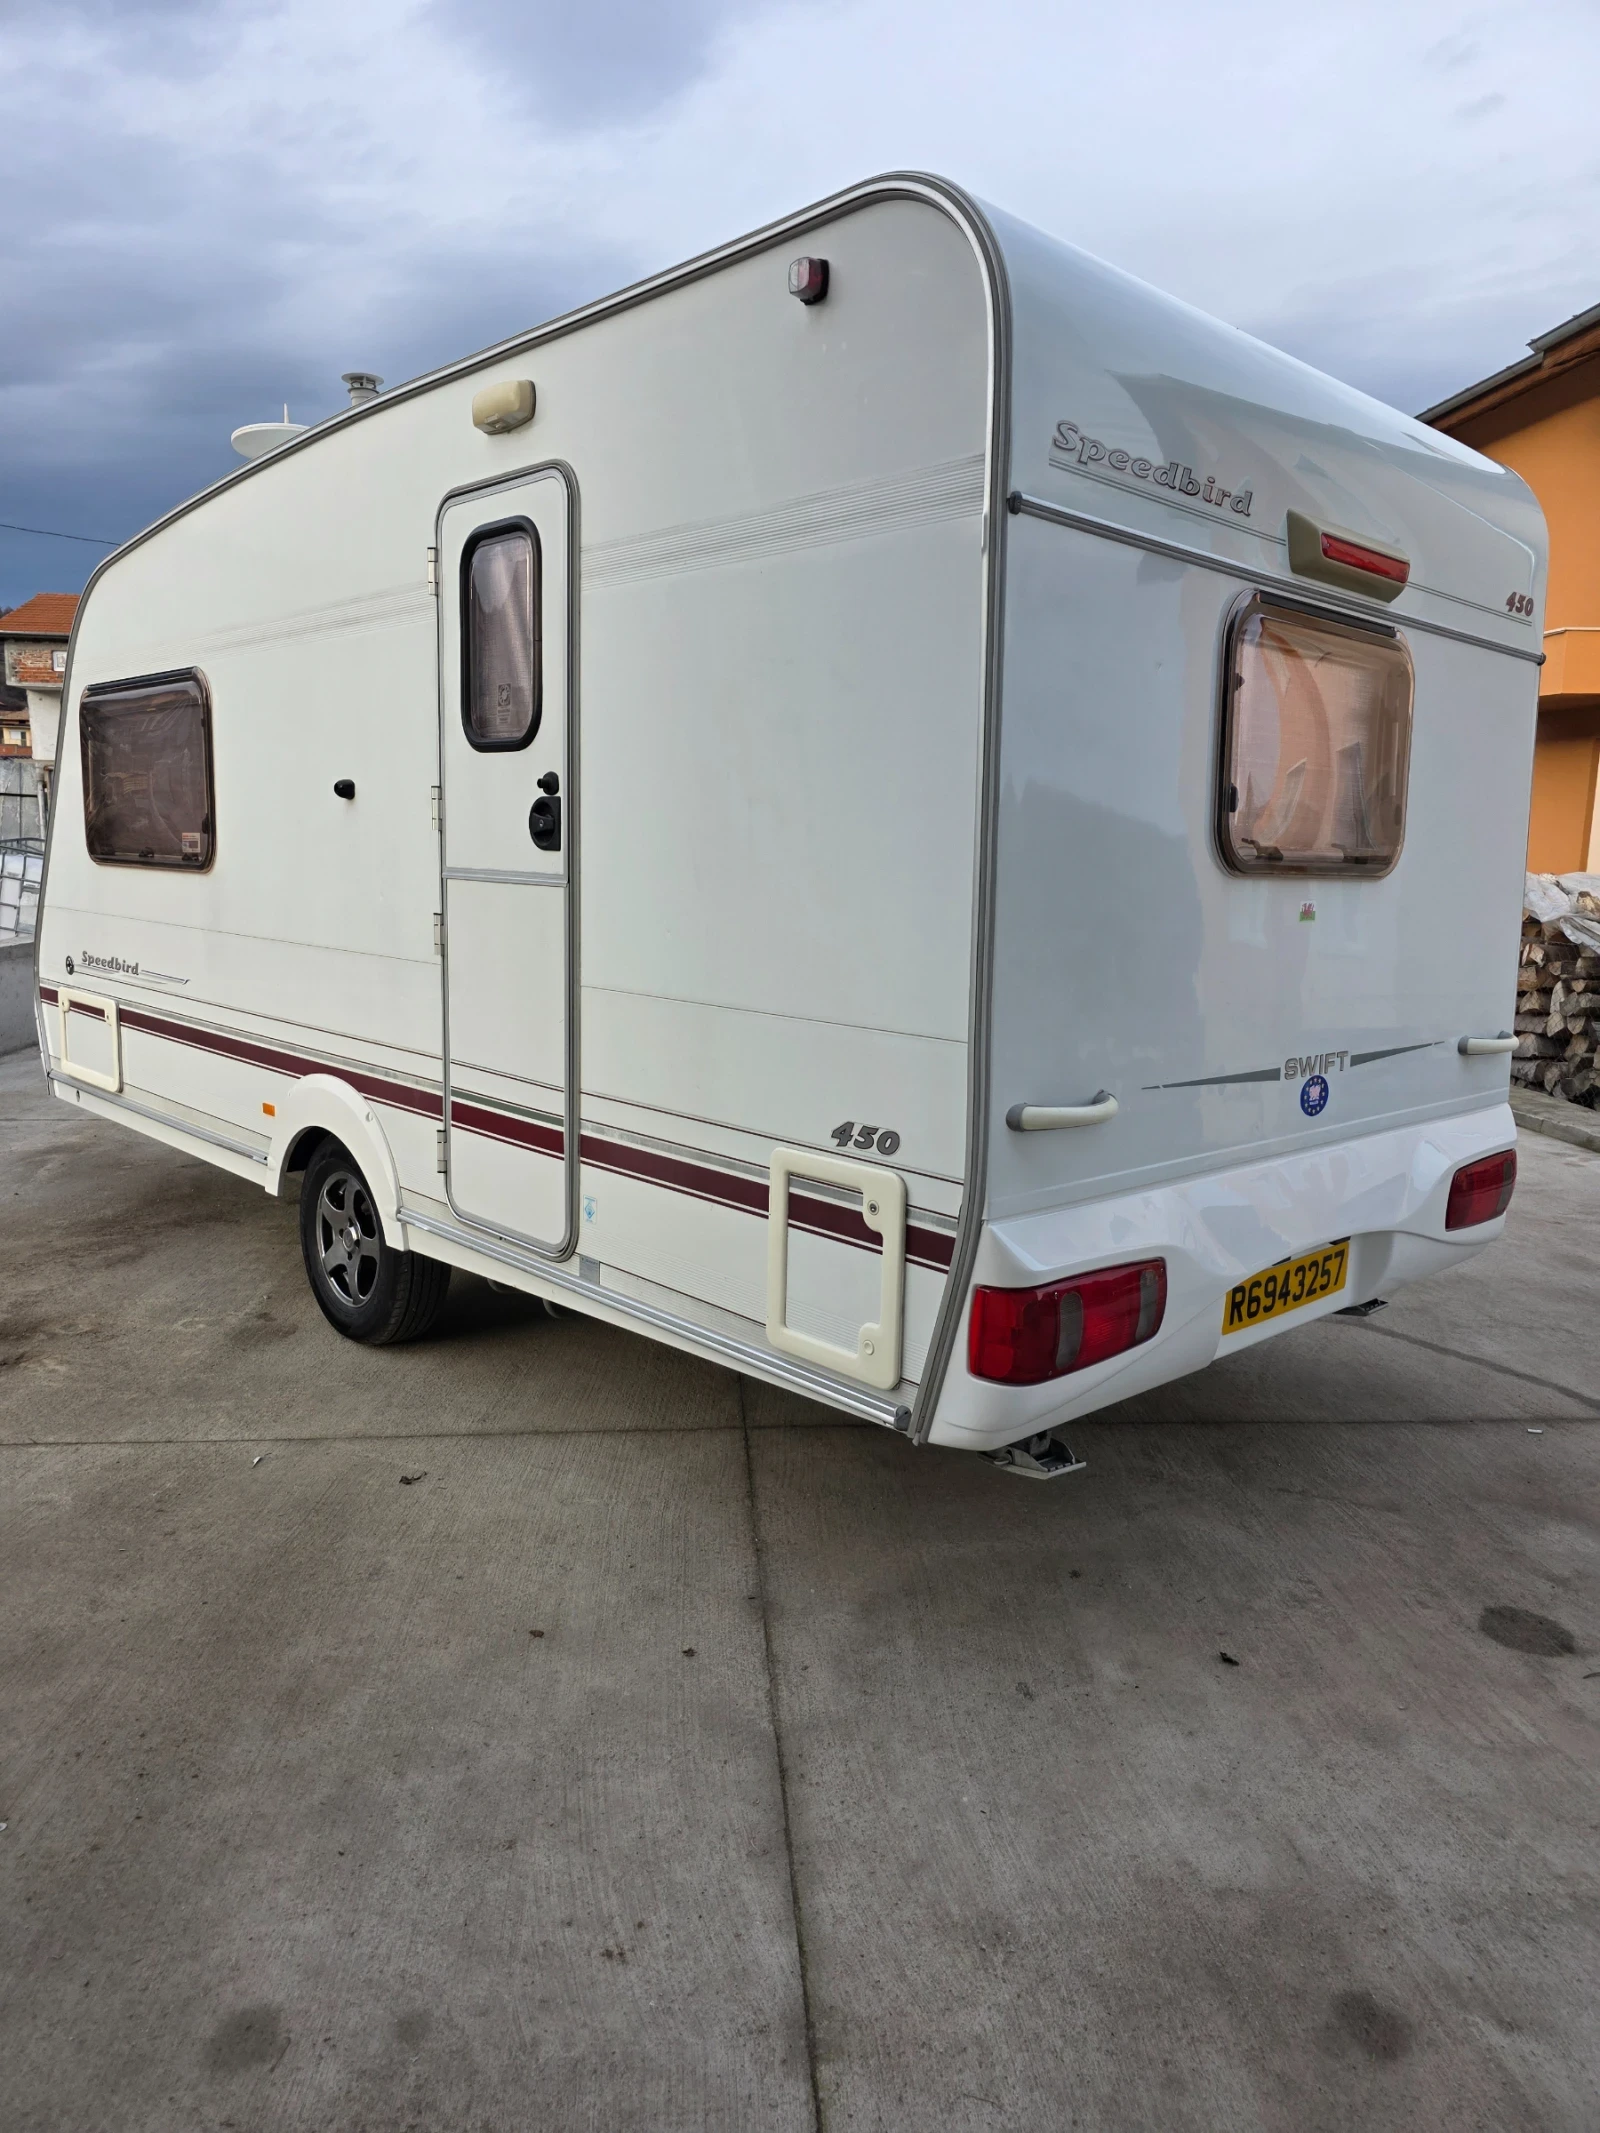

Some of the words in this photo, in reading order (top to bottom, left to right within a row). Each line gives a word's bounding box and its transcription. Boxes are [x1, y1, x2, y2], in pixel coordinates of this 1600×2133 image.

[1052, 420, 1254, 517] Speedbird
[1505, 591, 1534, 617] 450
[81, 950, 140, 976] Speedbird
[1284, 1050, 1349, 1080] SWIFT
[830, 1121, 901, 1156] 450
[1228, 1248, 1346, 1327] R6943257
